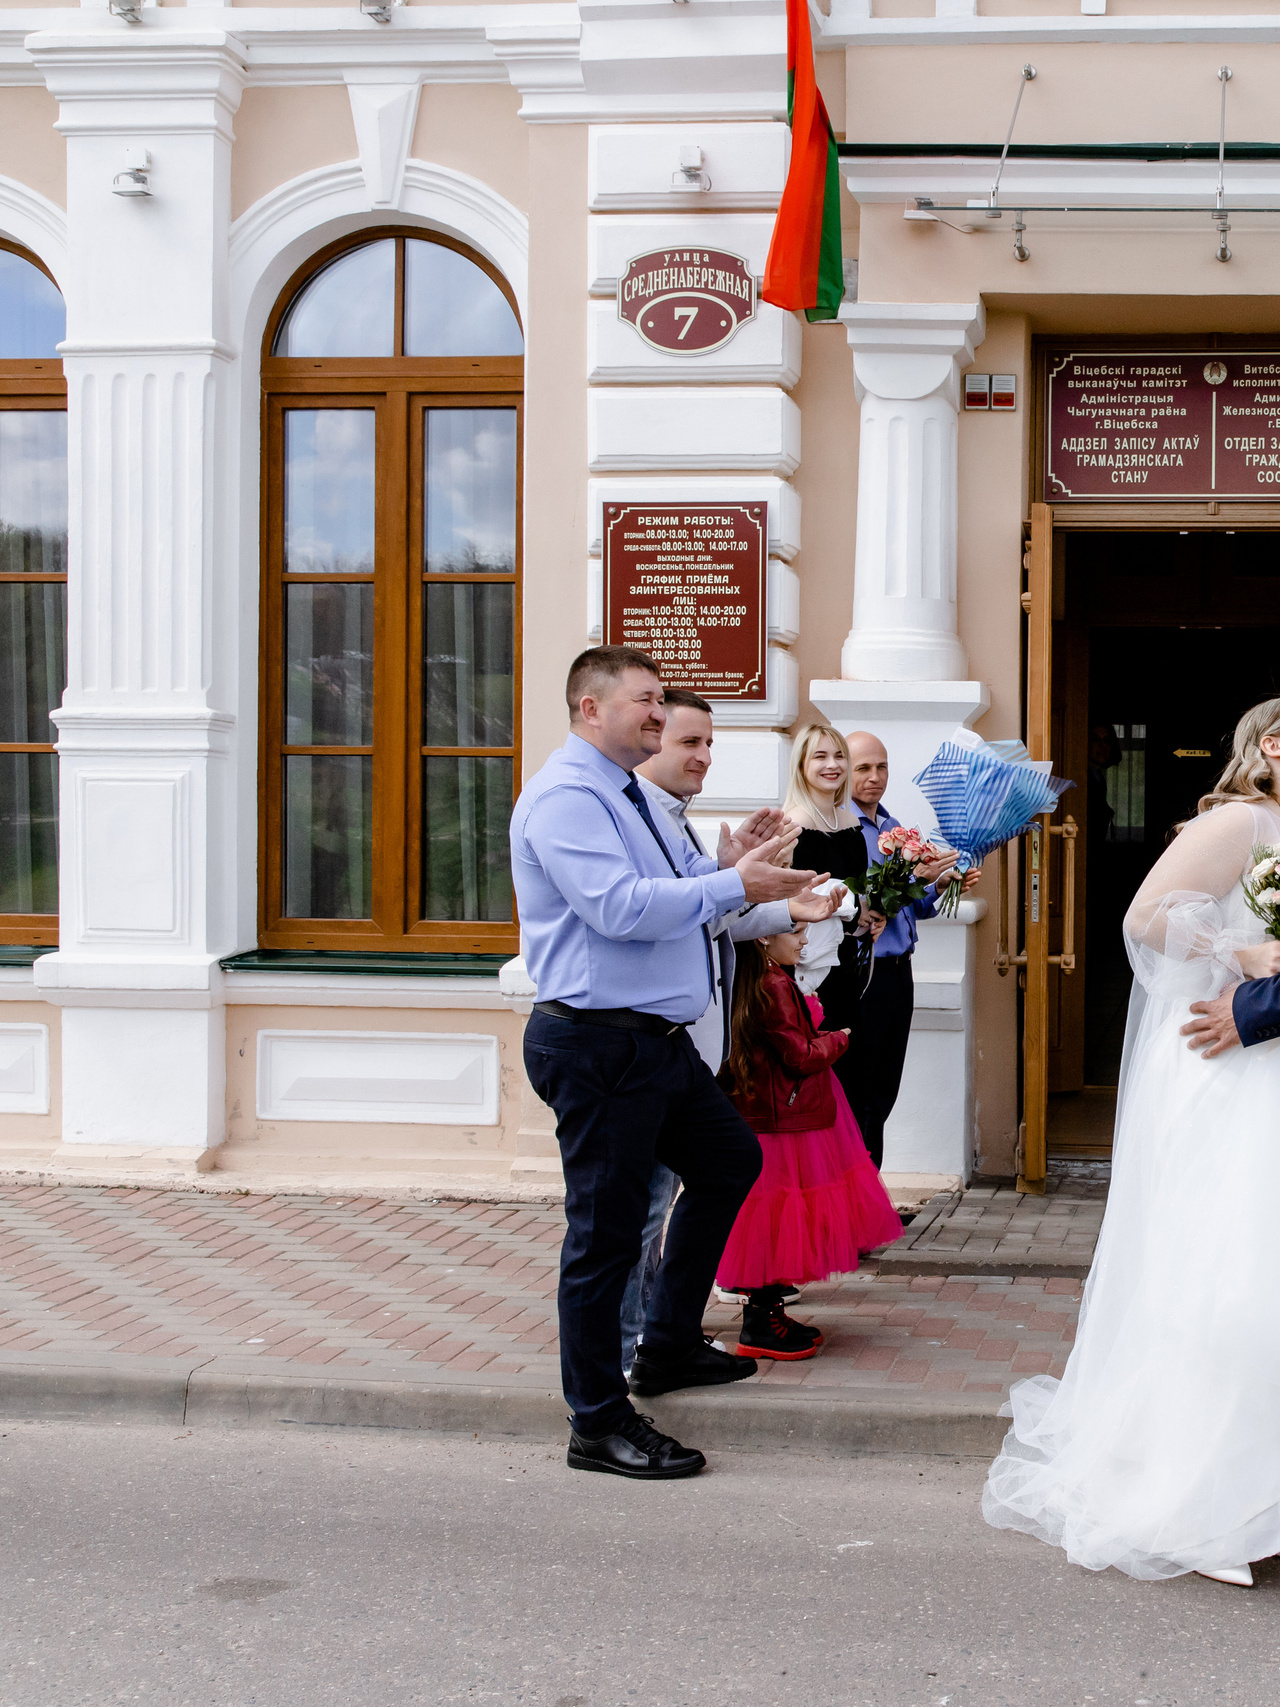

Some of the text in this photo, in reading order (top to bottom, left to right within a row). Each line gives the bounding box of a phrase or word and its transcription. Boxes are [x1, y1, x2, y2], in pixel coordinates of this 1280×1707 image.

[664, 252, 710, 266] улица
[624, 266, 749, 302] СРЕДНЕНАБЕРЕЖНАЯ
[674, 306, 699, 340] 7
[1074, 365, 1181, 376] Віцебскі гарадскі
[1068, 378, 1187, 390] выканаўчы камітэт
[1080, 393, 1174, 405] Адміністрацыя
[1067, 407, 1187, 418] Чыгуначнага раёна
[1095, 419, 1158, 430] г.Віцебска
[1061, 434, 1200, 452] АДДЗЕЛ ЗАПІСУ АКТАЎ
[1224, 437, 1265, 451] ОТДЕЛ
[1077, 454, 1184, 468] ГРАМАДЗЯНСКАГА
[1111, 471, 1148, 483] СТАНУ
[638, 516, 734, 525] РЕЖИМ РАБОТЫ:
[693, 529, 735, 538] 14.00-20.00
[709, 541, 748, 550] 14.00-17.00
[641, 574, 729, 584] ГРАФИК ПРИЁМА
[630, 585, 740, 594] ЗАИНТЕРЕСОВАННЫХ
[672, 596, 697, 605] ЛИЦ:
[700, 606, 746, 615] 14.00-20.00
[697, 617, 741, 626] 14.00-17.00
[650, 628, 697, 637] 08.00-13.00
[652, 639, 702, 648] 08.00-09.00
[652, 651, 701, 659] 08.00-09.00
